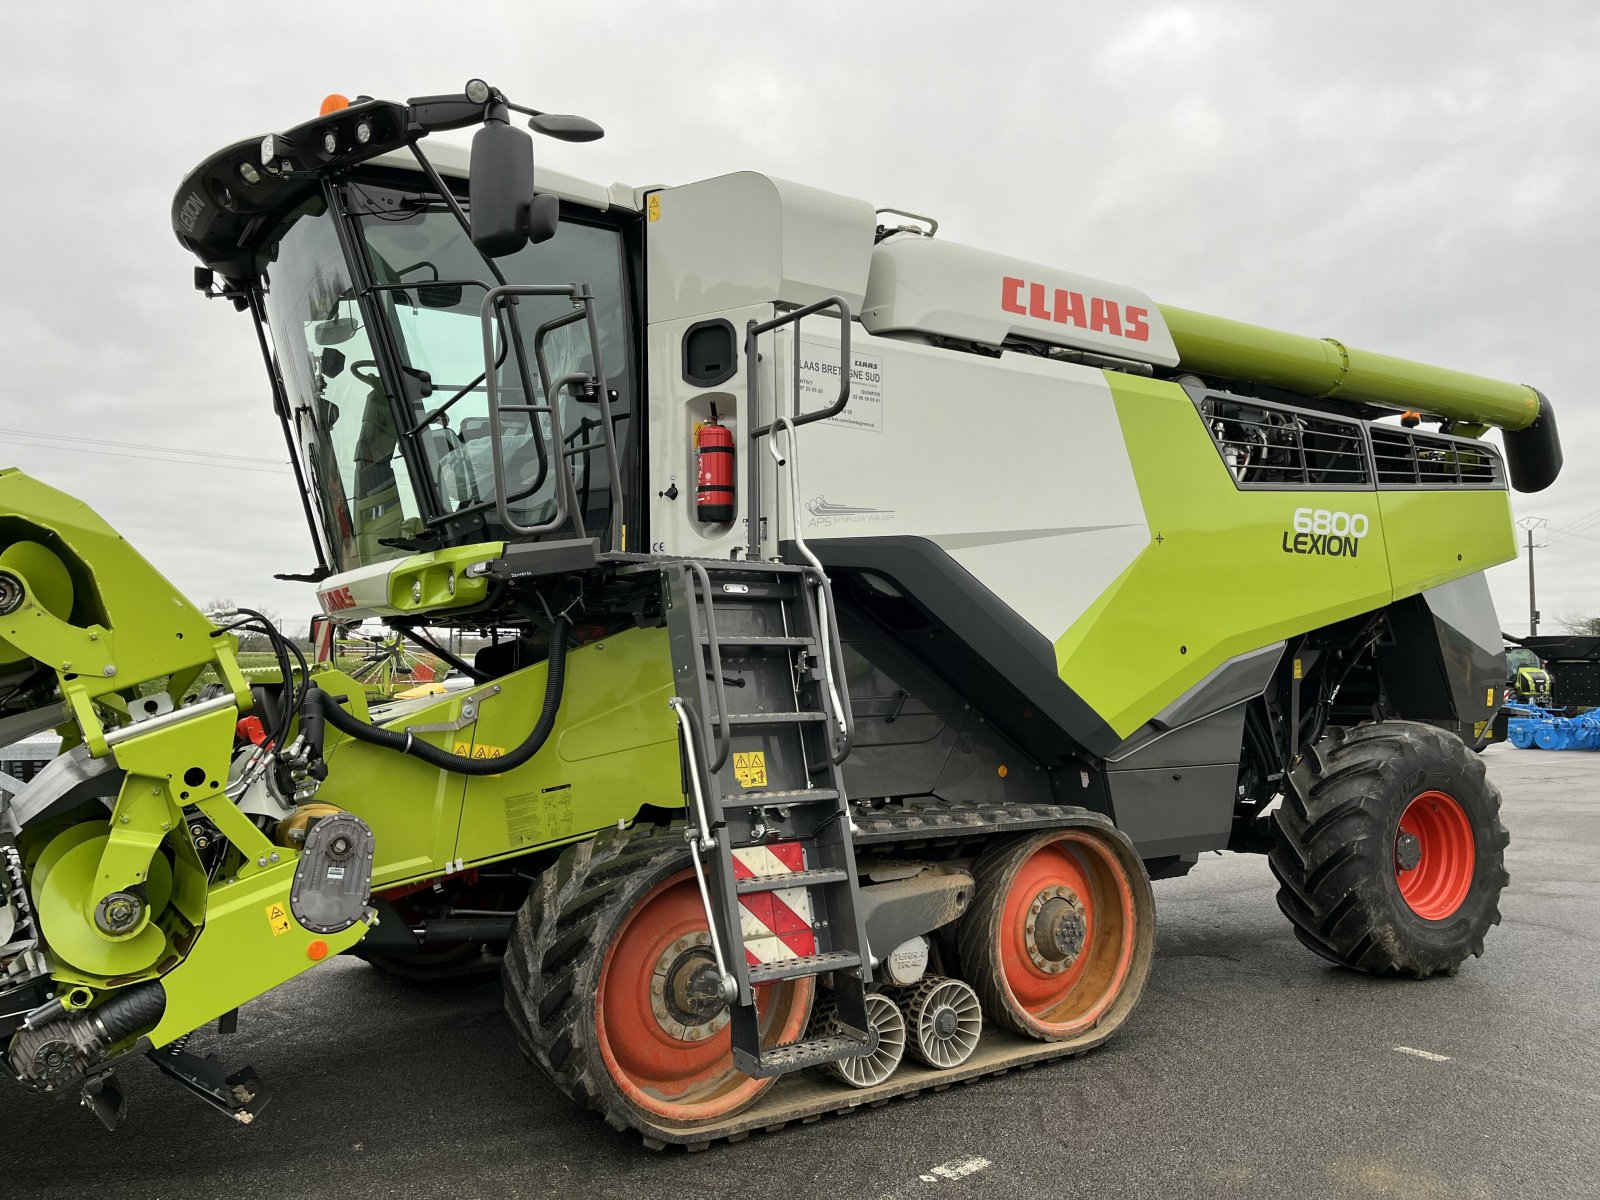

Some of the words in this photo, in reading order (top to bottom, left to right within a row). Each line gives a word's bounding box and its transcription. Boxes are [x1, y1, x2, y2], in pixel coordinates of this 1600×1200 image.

[179, 191, 206, 232] LEXION
[1001, 276, 1149, 342] CLAAS
[799, 360, 820, 372] LAAS
[821, 364, 864, 380] BRETGNE
[864, 371, 881, 383] SUD
[854, 360, 878, 370] CLAAS
[807, 517, 832, 528] APS
[1293, 507, 1369, 538] 6800
[1282, 531, 1359, 558] LEXION
[893, 951, 924, 961] TERRA
[897, 960, 922, 970] TRAC
